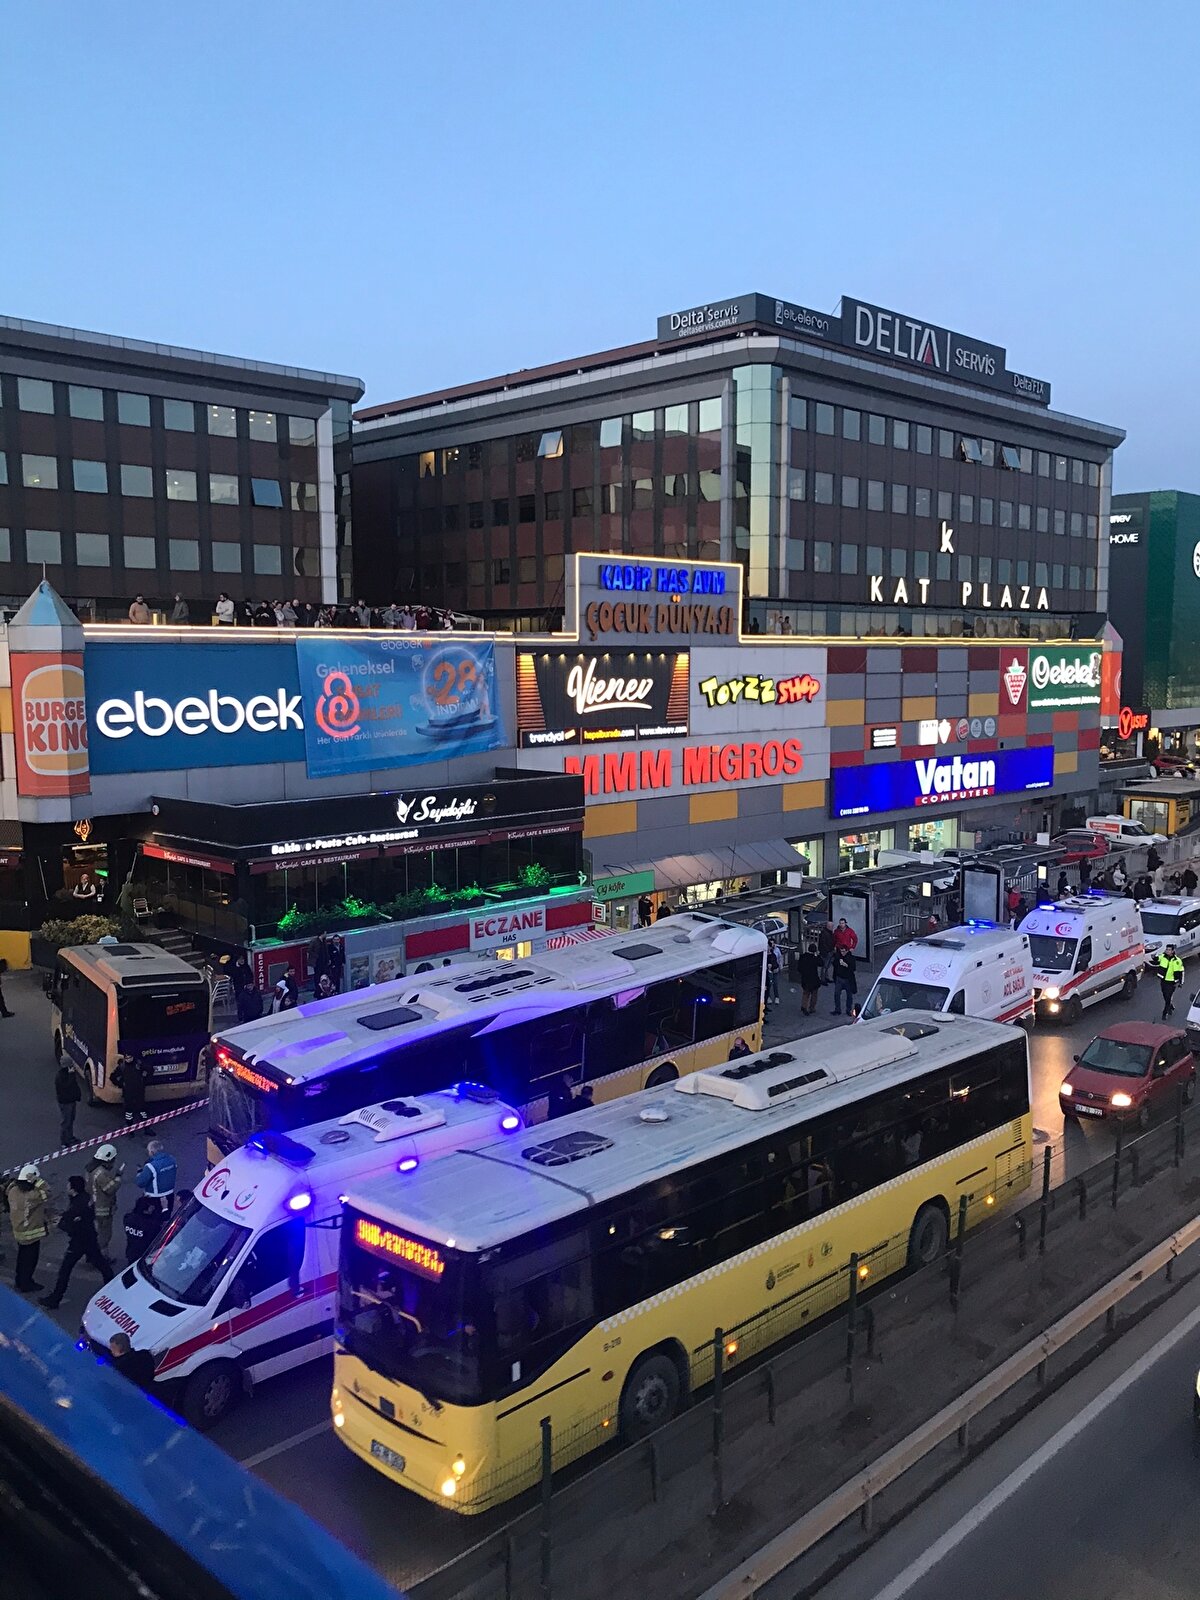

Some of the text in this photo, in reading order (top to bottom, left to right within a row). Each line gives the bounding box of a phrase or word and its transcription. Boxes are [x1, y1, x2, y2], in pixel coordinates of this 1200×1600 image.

[670, 304, 739, 331] Delta Servis
[678, 316, 738, 337] deltaservis.com.tr
[855, 305, 940, 368] DELTA
[657, 568, 689, 593] HAS
[692, 570, 726, 595] AVM
[870, 575, 1049, 610] KAT PLAZA
[586, 594, 734, 641] ÇOCUK DÜNYASI
[380, 639, 423, 650] ebebek
[315, 659, 395, 678] Geleneksel
[775, 674, 820, 705] SHOP
[25, 700, 85, 721] BURGE
[96, 687, 305, 739] ebebek
[317, 736, 332, 745] Her
[529, 730, 565, 743] trendyol
[914, 755, 995, 795] Vatan
[921, 788, 989, 804] COMPUTER
[413, 795, 478, 823] Seyidoğlu
[542, 826, 570, 834] RESTAURANT
[444, 839, 477, 848] RESTAURANT
[323, 853, 360, 863] RESTAURANT
[474, 910, 543, 939] ECZANE
[502, 933, 516, 943] HAS
[209, 1175, 225, 1192] 112
